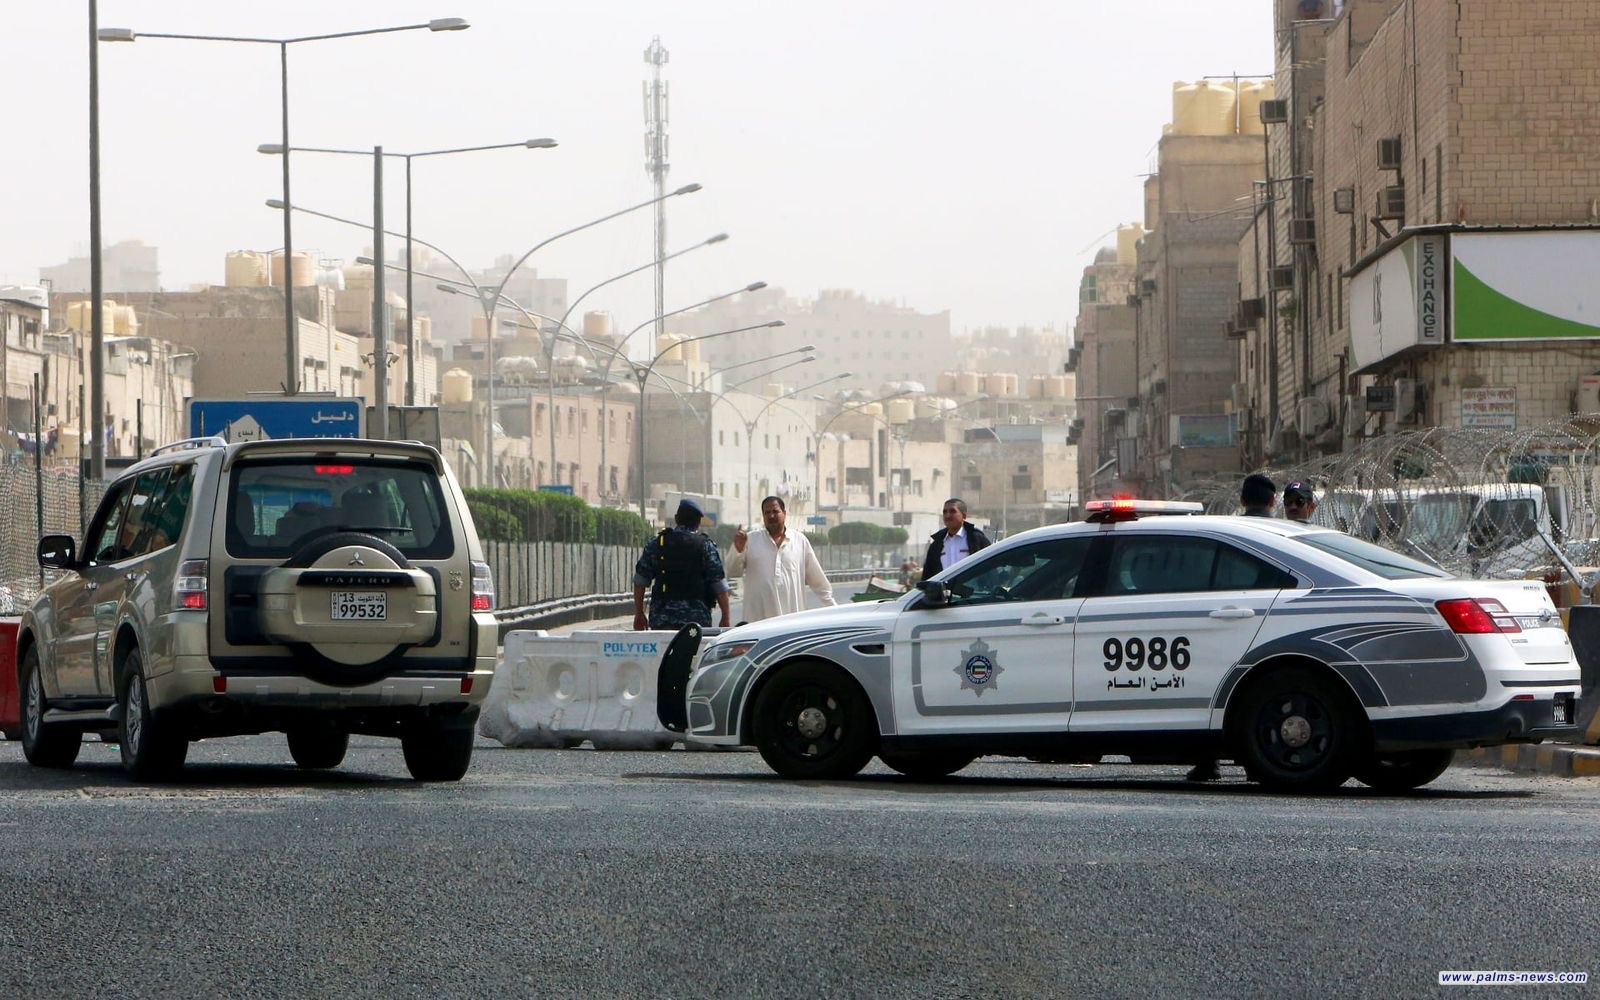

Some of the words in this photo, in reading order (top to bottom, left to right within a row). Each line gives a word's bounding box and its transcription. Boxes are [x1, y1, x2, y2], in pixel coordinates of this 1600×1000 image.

[1423, 242, 1435, 338] EXCHANGE
[311, 410, 355, 424] دليل
[340, 604, 385, 618] 99532
[1522, 618, 1540, 628] POLICE
[603, 642, 658, 653] POLYTEX
[1103, 636, 1191, 672] 9986
[1107, 676, 1146, 691] العام
[1151, 673, 1185, 692] الأمن
